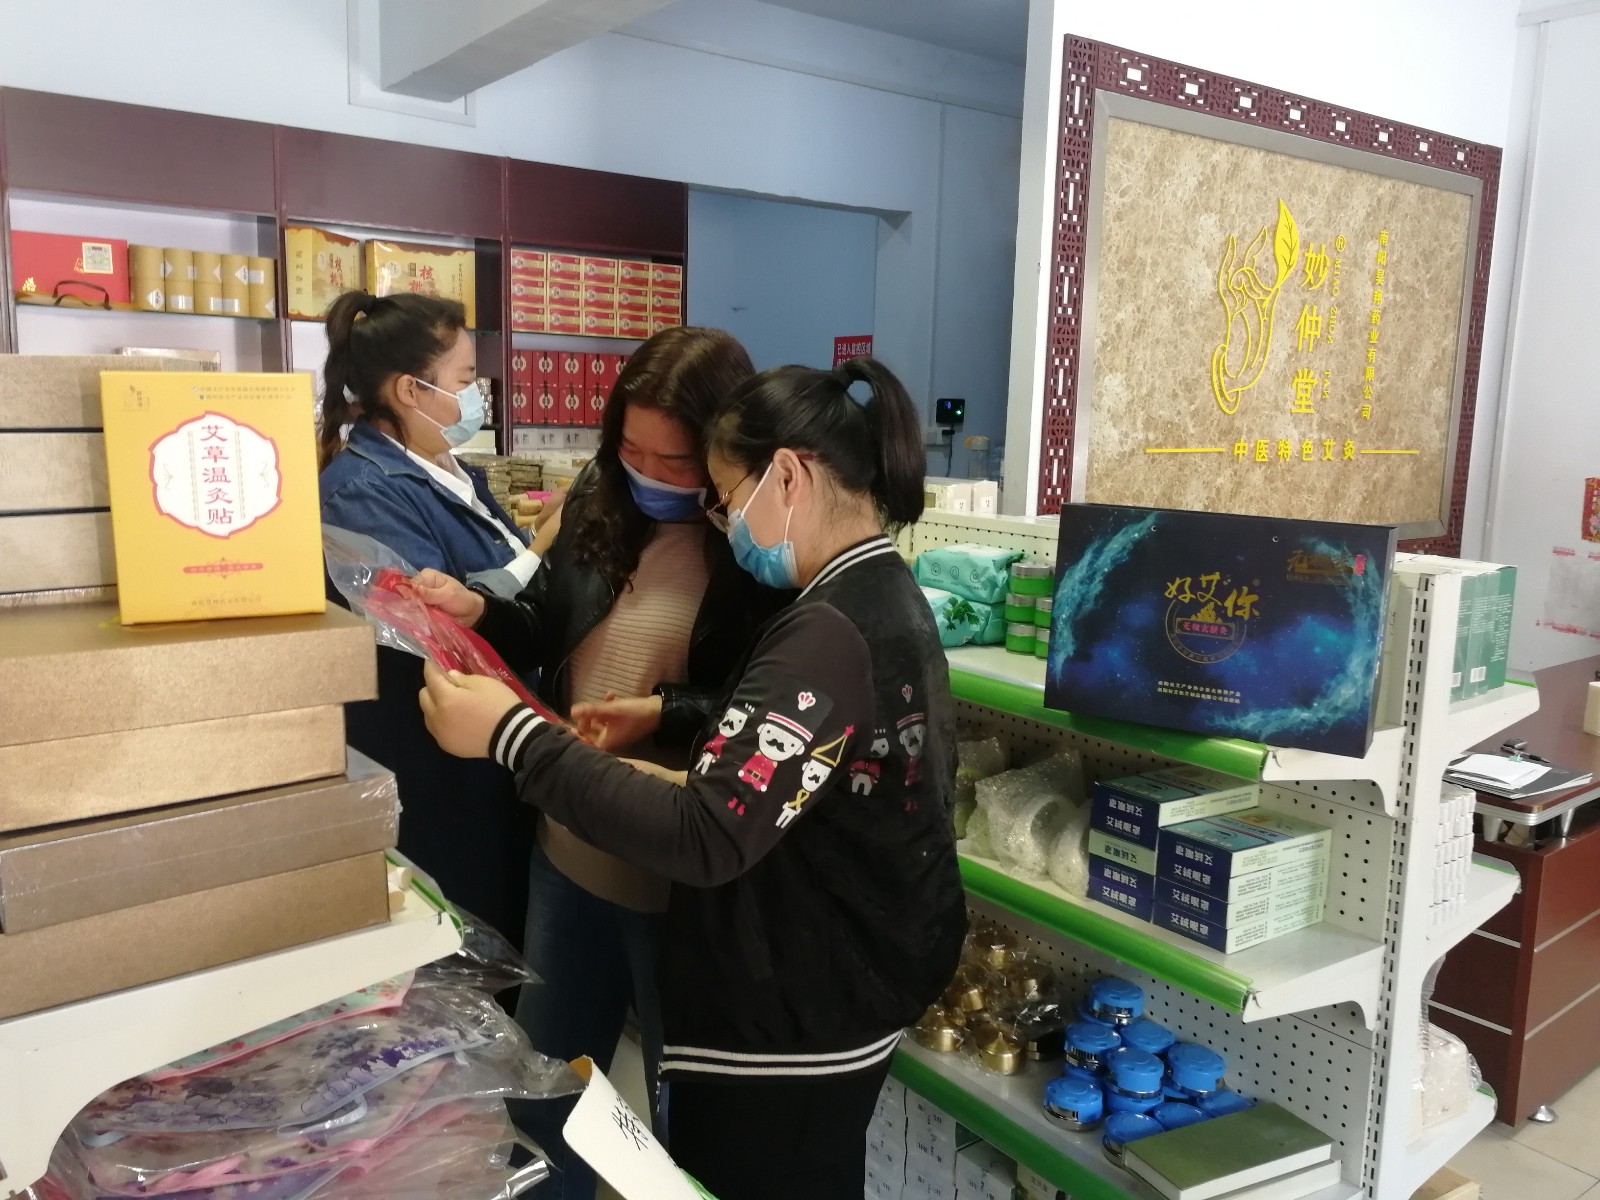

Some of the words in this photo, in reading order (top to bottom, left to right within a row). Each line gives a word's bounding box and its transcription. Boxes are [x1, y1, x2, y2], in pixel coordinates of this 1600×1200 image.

[1332, 258, 1343, 297] MIAO
[1290, 242, 1331, 414] 妙仲堂
[199, 424, 235, 525] 艾草温灸贴
[1233, 437, 1356, 462] 中医特色艾灸
